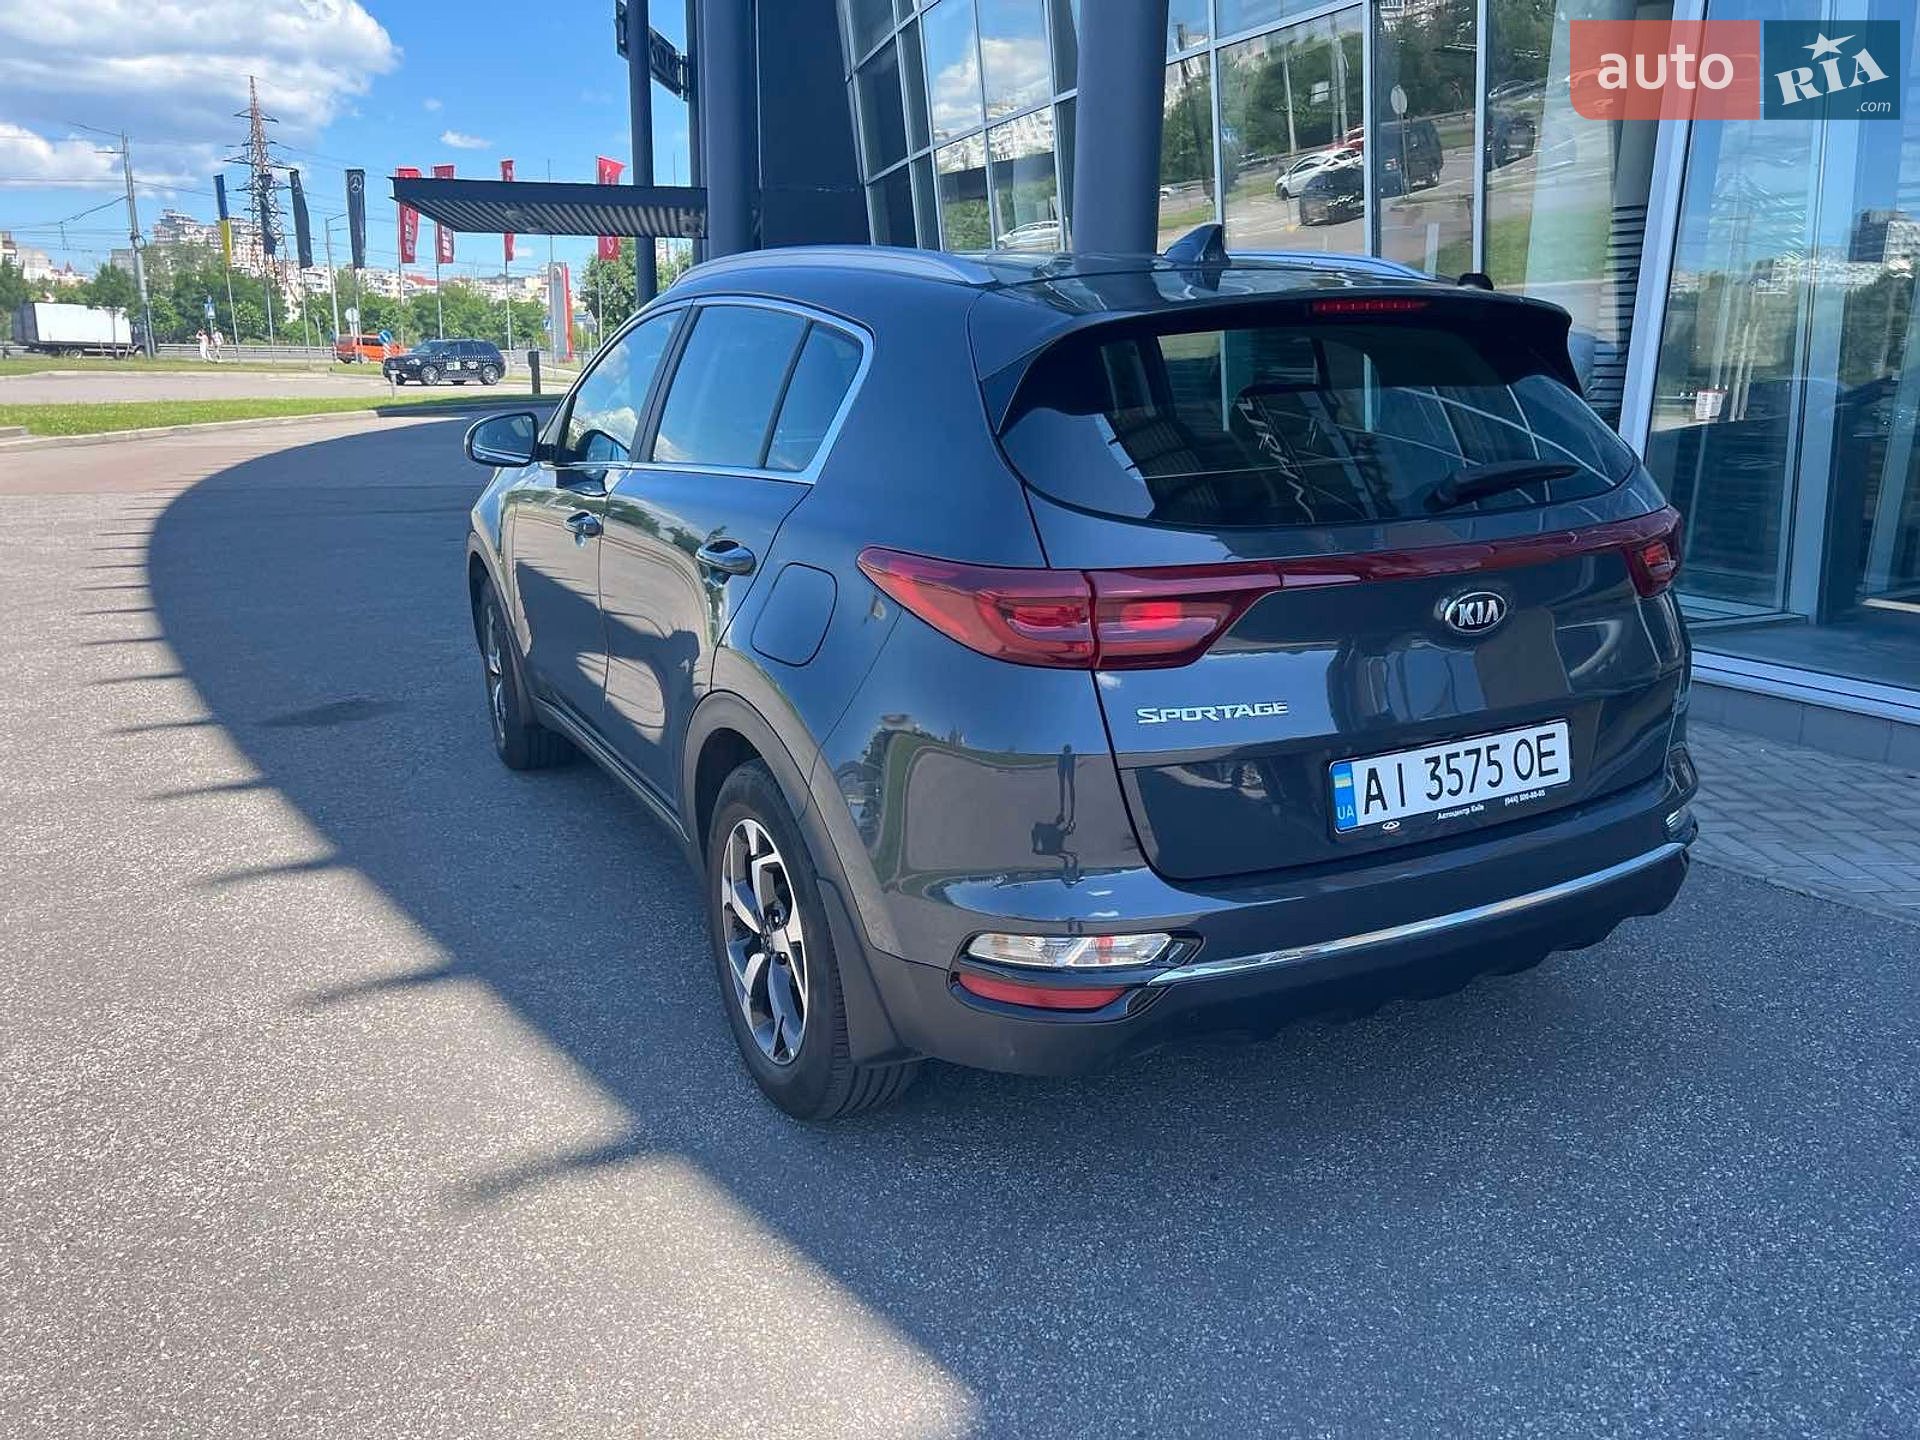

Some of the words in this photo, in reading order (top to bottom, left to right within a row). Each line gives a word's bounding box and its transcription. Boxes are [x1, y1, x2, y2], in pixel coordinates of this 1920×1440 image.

[1457, 601, 1500, 626] KIA
[1136, 702, 1289, 723] SPORTAGE
[1424, 744, 1504, 801] 3575
[1513, 732, 1559, 781] OE
[1337, 805, 1355, 820] UA
